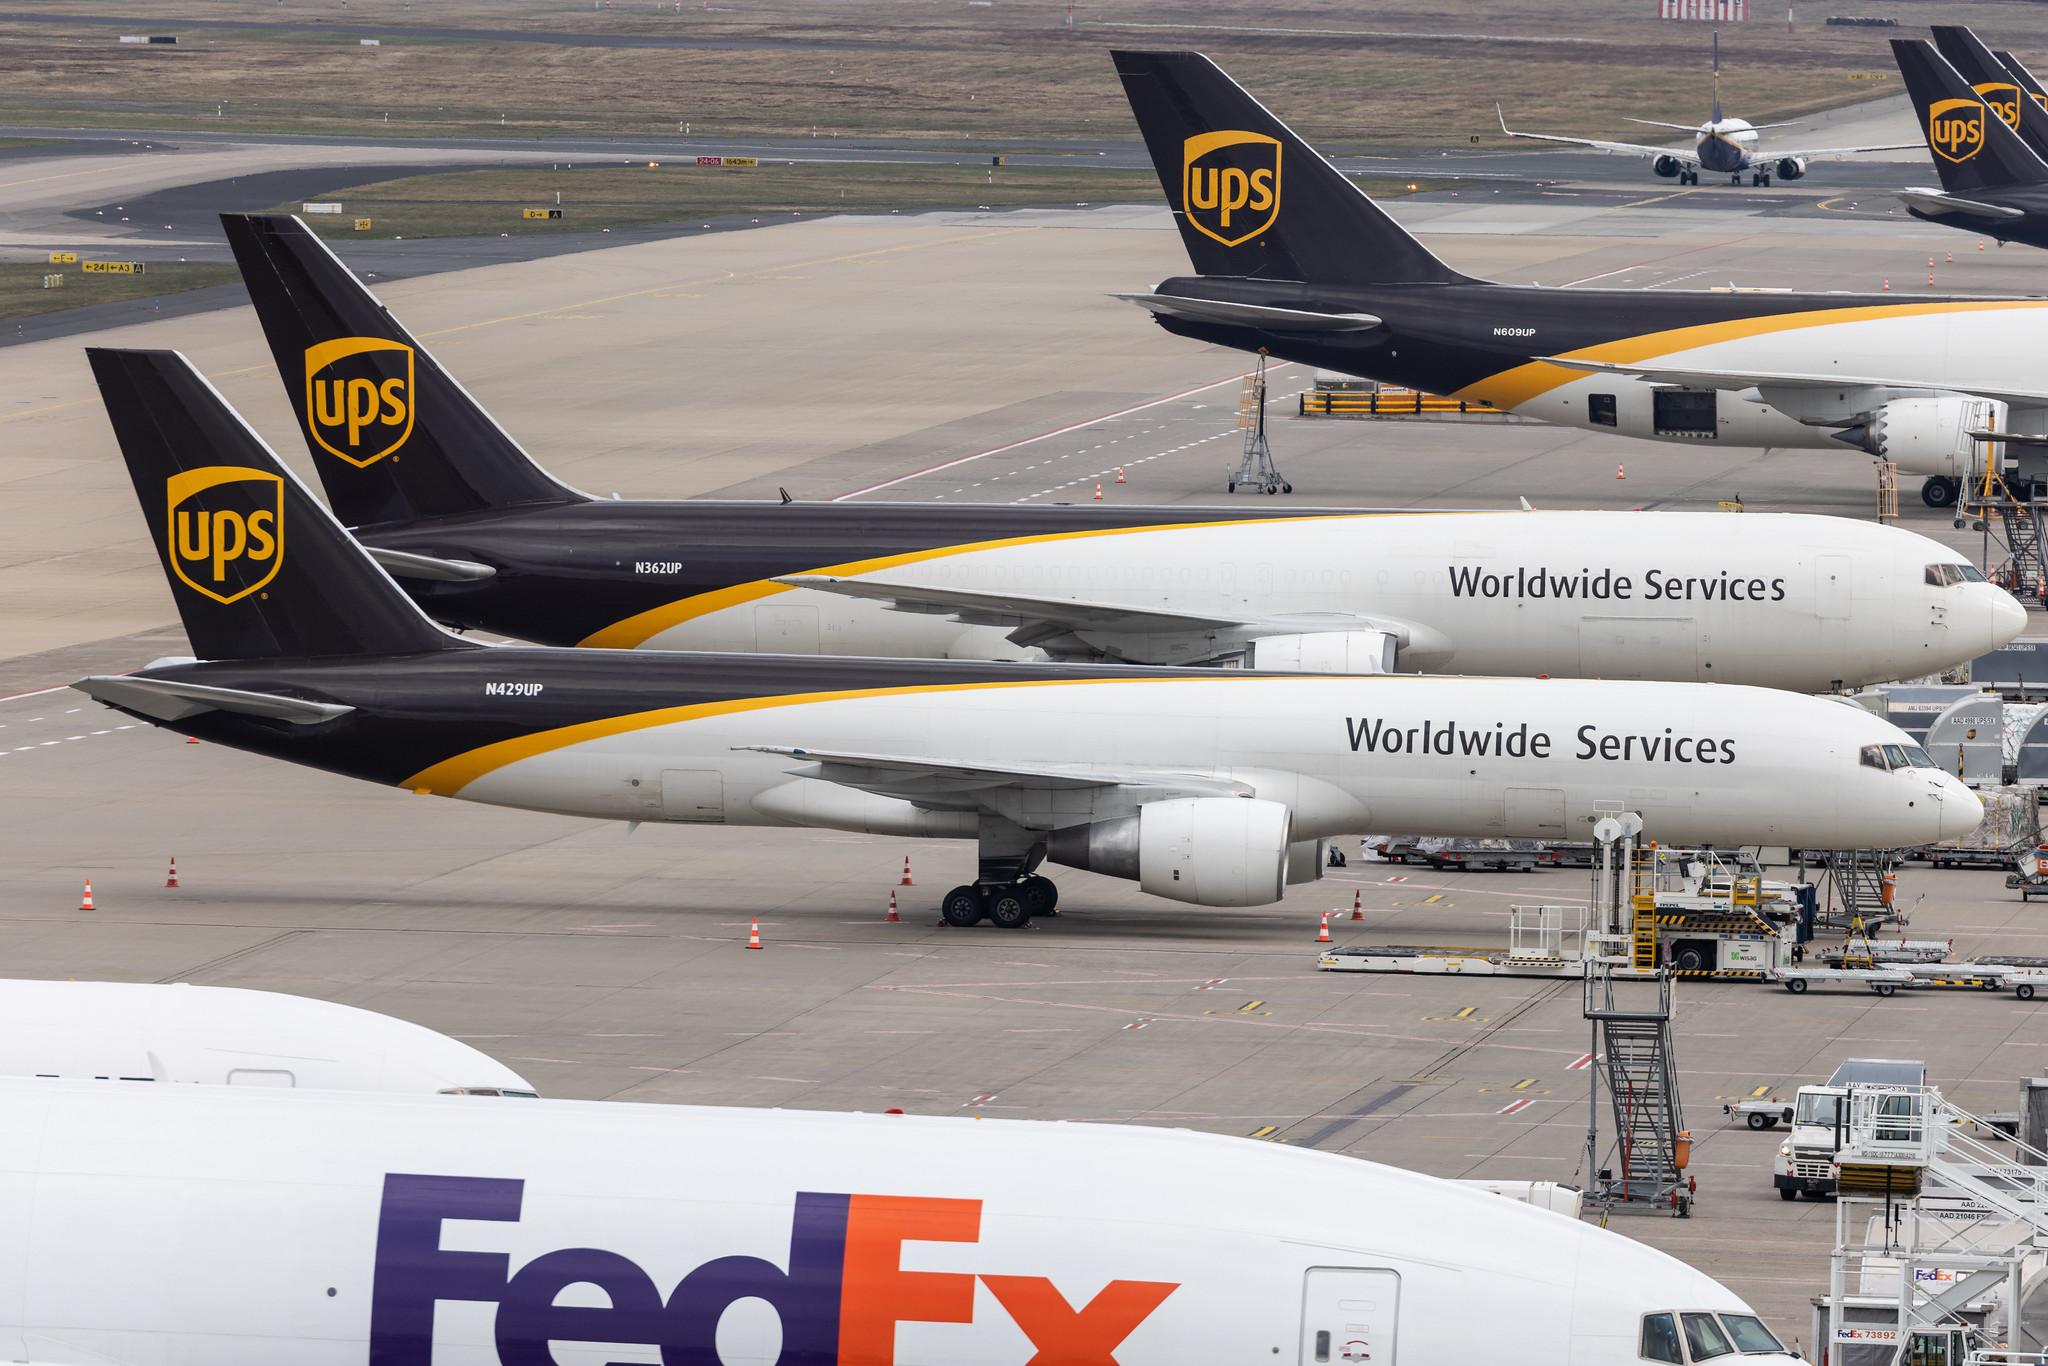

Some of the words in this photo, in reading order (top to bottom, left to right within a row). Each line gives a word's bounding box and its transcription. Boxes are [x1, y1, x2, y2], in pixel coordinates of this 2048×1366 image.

[1191, 167, 1273, 227] ups
[93, 263, 105, 271] 24
[118, 264, 130, 272] A3
[1493, 327, 1536, 337] N609UP
[315, 377, 406, 446] ups
[178, 509, 275, 581] ups
[635, 561, 682, 574] N362UP
[1449, 566, 1633, 600] Worldwide
[1644, 569, 1786, 601] Services
[485, 682, 543, 696] N429UP
[1346, 717, 1551, 758] Worldwide
[1576, 724, 1736, 764] Services
[369, 1173, 1182, 1366] FedEx
[1915, 1268, 1952, 1280] FedEx
[1837, 1329, 1862, 1338] FedEx
[1864, 1330, 1896, 1339] 73892
